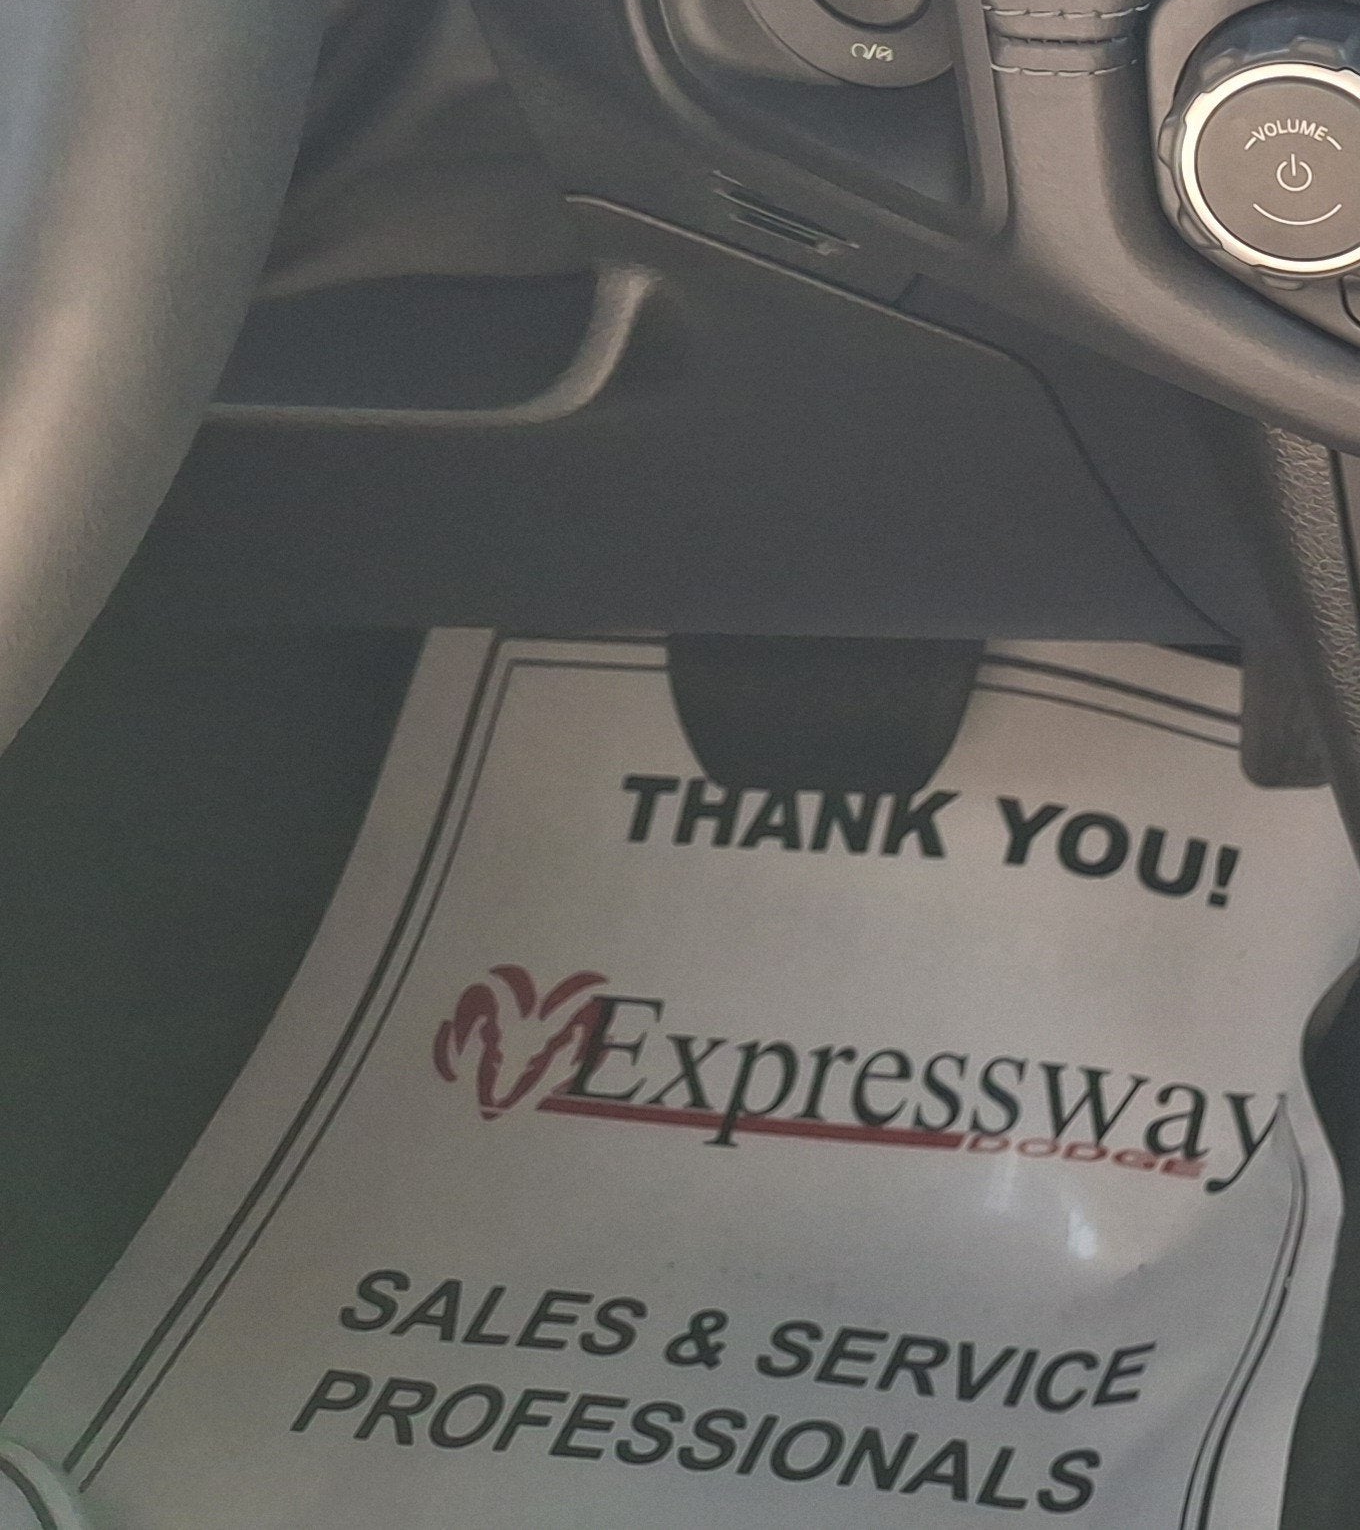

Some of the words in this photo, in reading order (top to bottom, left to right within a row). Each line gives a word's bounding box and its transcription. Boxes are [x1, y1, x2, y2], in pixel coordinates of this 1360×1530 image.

[1251, 118, 1329, 143] VOLUME
[621, 774, 962, 860] THANK
[996, 796, 1242, 909] YOU!
[564, 992, 1291, 1196] Expressway
[960, 1134, 1203, 1181] DODGE
[338, 1268, 648, 1356] SALES
[665, 1308, 731, 1371] &
[755, 1318, 1158, 1416] SERVICE
[290, 1367, 1102, 1515] PROFESSIONALS
